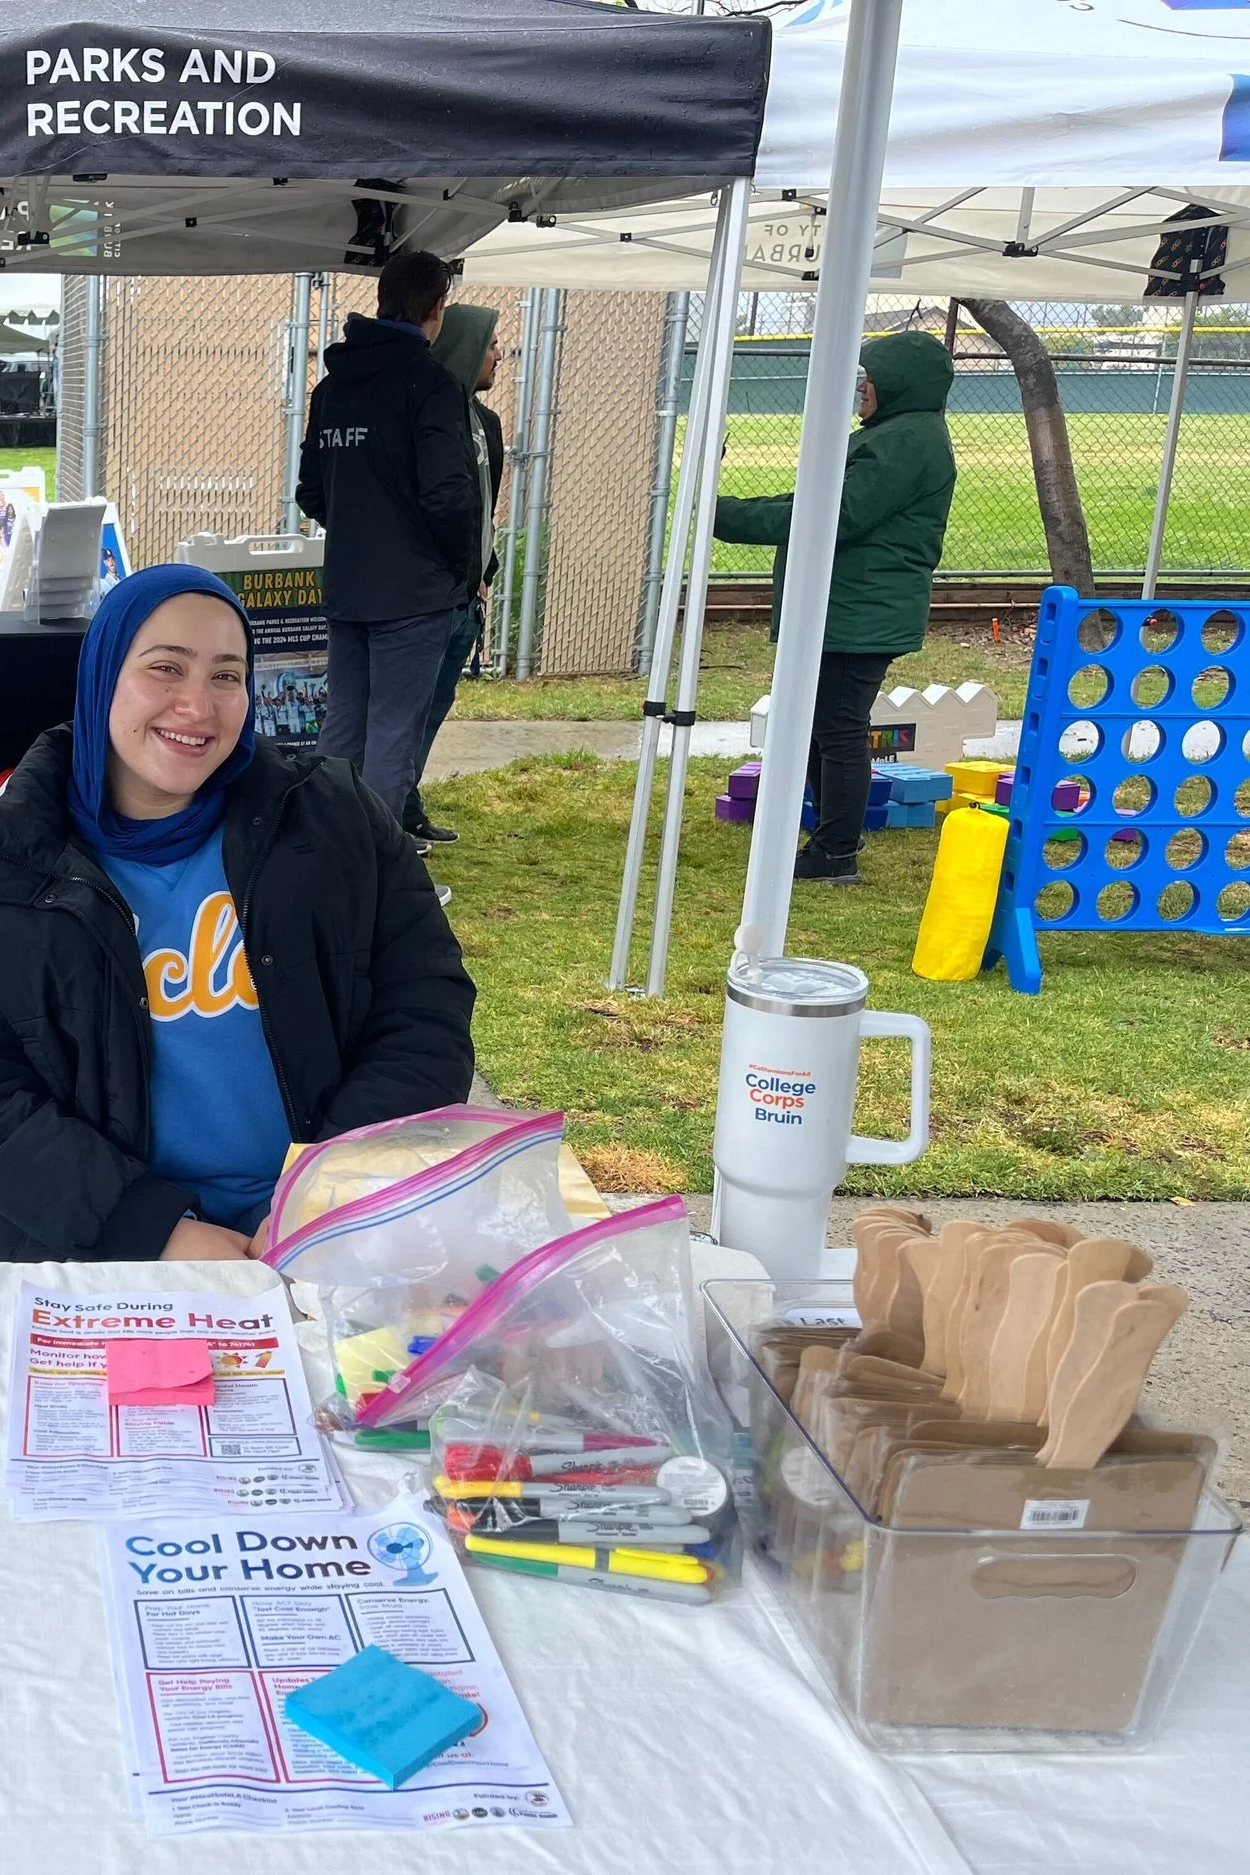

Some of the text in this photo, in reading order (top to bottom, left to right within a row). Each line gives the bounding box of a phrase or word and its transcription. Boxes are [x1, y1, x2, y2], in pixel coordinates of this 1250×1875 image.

[26, 48, 277, 86] PARKS AND
[26, 100, 302, 137] RECREATION
[243, 570, 315, 591] BURBANK
[238, 590, 292, 608] GALAXY
[311, 633, 328, 641] CHAM
[868, 729, 909, 749] TRIS
[140, 889, 259, 1022] cl
[745, 1073, 816, 1097] College
[749, 1088, 805, 1110] Corps
[754, 1107, 803, 1125] Bruin
[34, 1297, 174, 1312] Stay Safe During
[32, 1308, 274, 1330] Extreme Heat
[30, 1349, 81, 1359] Monitor
[29, 1358, 98, 1369] Get help if
[125, 1530, 359, 1557] Cool Down
[127, 1558, 372, 1585] Your Home
[198, 1585, 217, 1593] and
[264, 1585, 297, 1593] energy
[299, 1583, 323, 1591] while
[326, 1581, 360, 1591] staying
[357, 1597, 395, 1605] Conserve
[260, 1634, 284, 1642] Make
[158, 1677, 230, 1687] Get Help Paying
[181, 1685, 214, 1693] Energy
[422, 1809, 451, 1822] RISING
